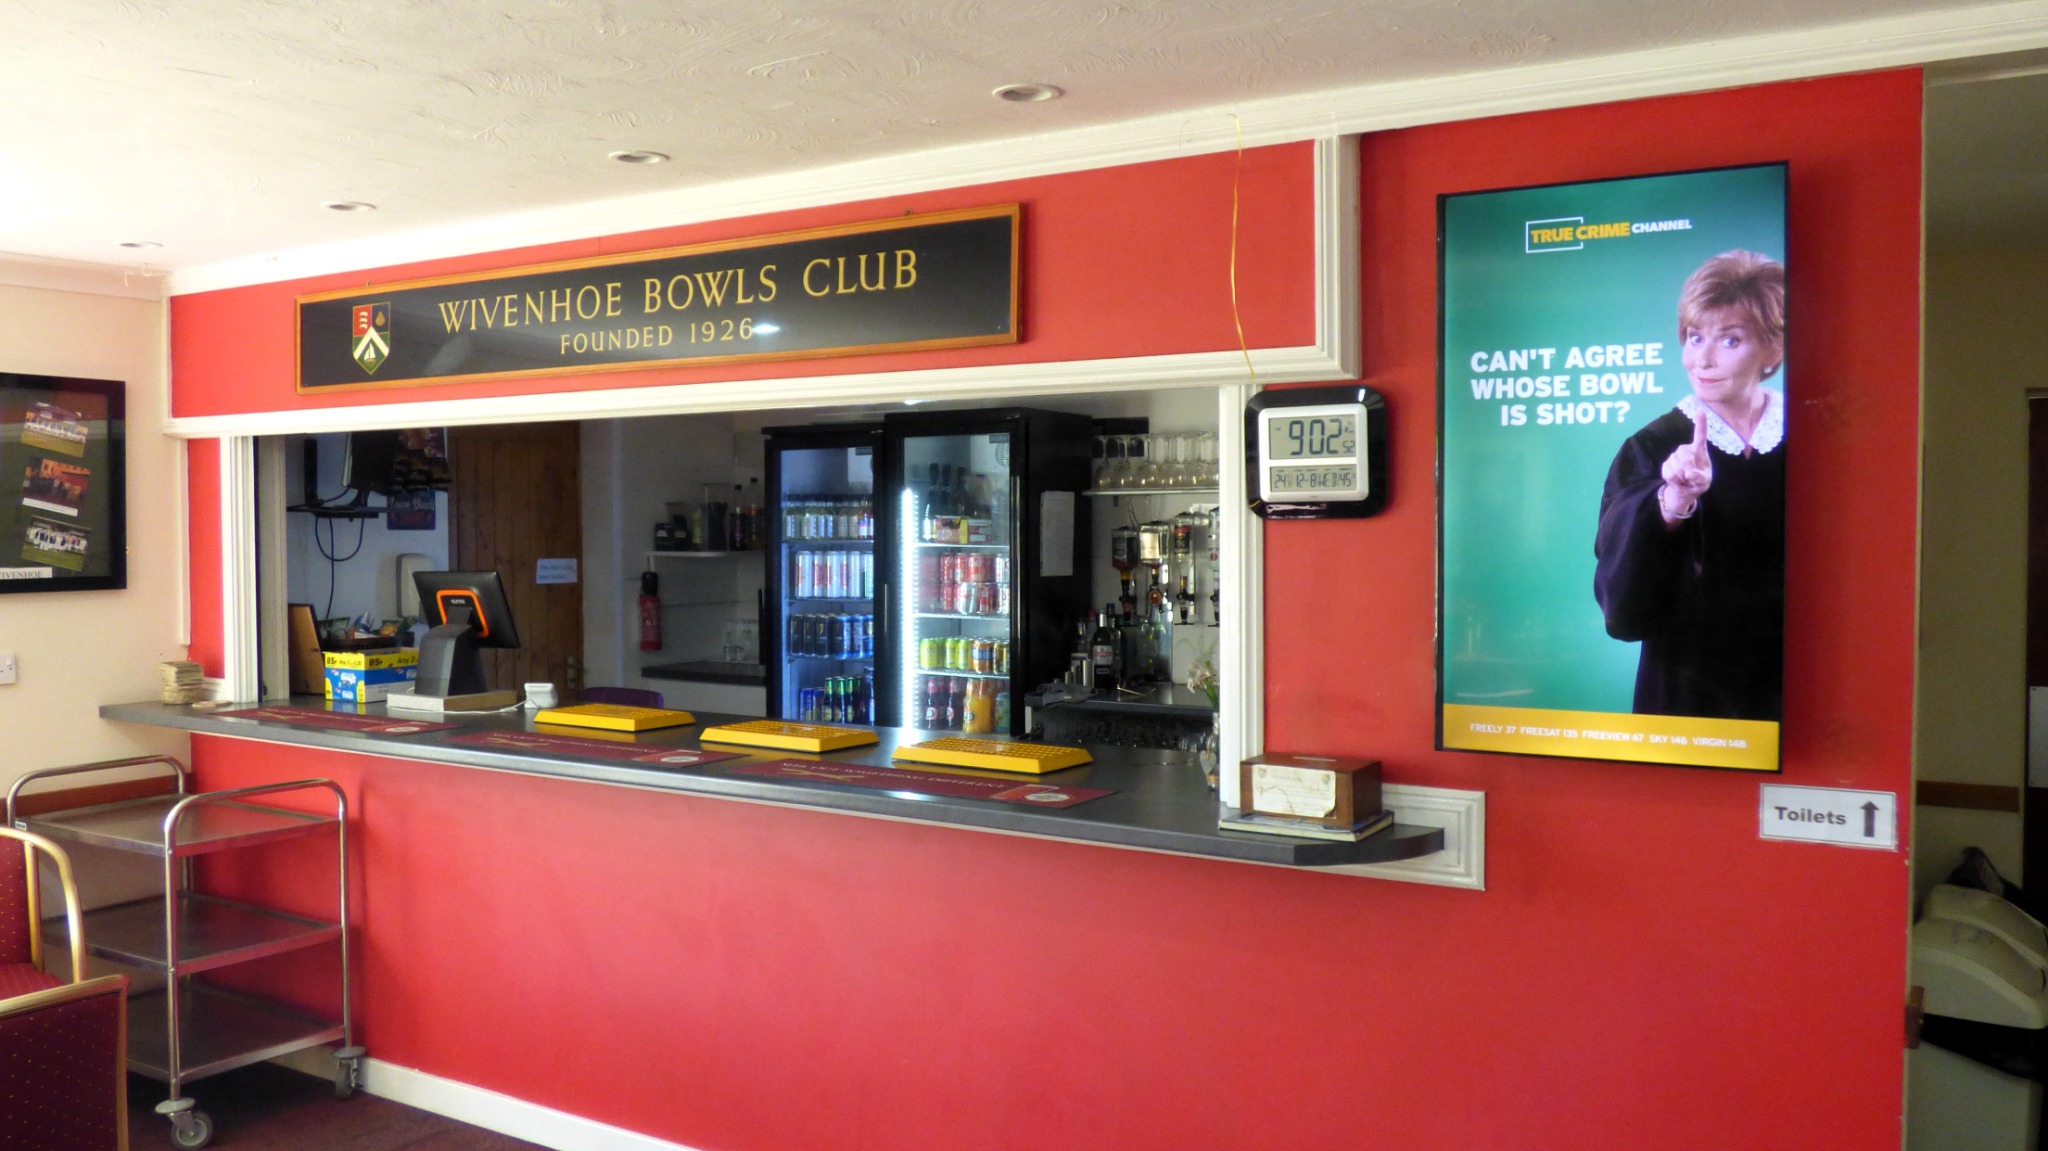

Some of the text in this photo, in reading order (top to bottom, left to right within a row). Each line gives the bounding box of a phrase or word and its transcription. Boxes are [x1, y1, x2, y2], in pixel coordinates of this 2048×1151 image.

[1530, 219, 1692, 243] TRUE CRIME CHANNEL
[438, 249, 917, 334] WIVENHOE BOWLS CLUB
[560, 318, 752, 354] FOUNDED 1926
[1471, 343, 1663, 372] CAN'T AGREE
[1471, 372, 1663, 399] WHOSE BOWL
[1501, 401, 1630, 426] IS SHOT?
[1470, 723, 1503, 733] FREELY
[1505, 725, 1516, 734] 37
[1521, 726, 1560, 736] FREESAT
[1564, 729, 1578, 738] 135
[1582, 729, 1630, 741] FREEVIEW
[1632, 733, 1644, 742] 67
[1649, 734, 1668, 743] SKY
[1693, 737, 1726, 747] VIRGIN
[1775, 806, 1847, 825] Toilets
